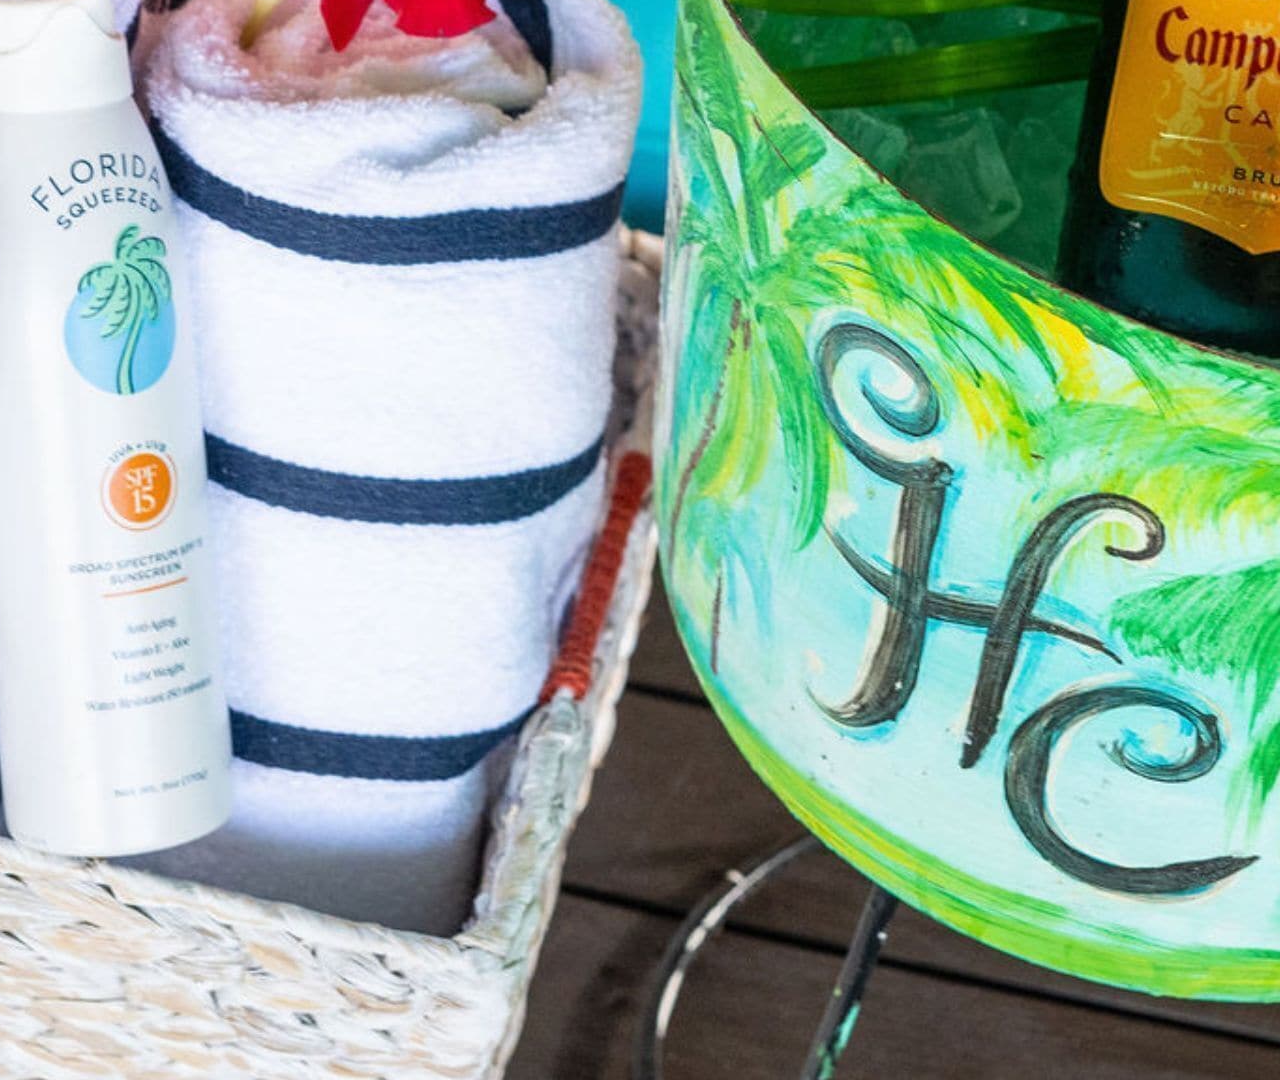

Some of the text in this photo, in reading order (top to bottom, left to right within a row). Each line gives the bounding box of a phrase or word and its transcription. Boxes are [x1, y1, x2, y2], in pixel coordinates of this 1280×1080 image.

[30, 152, 163, 213] FLORIDA
[55, 186, 163, 231] SQUEEZED
[124, 463, 160, 491] SPF
[132, 485, 157, 515] 15
